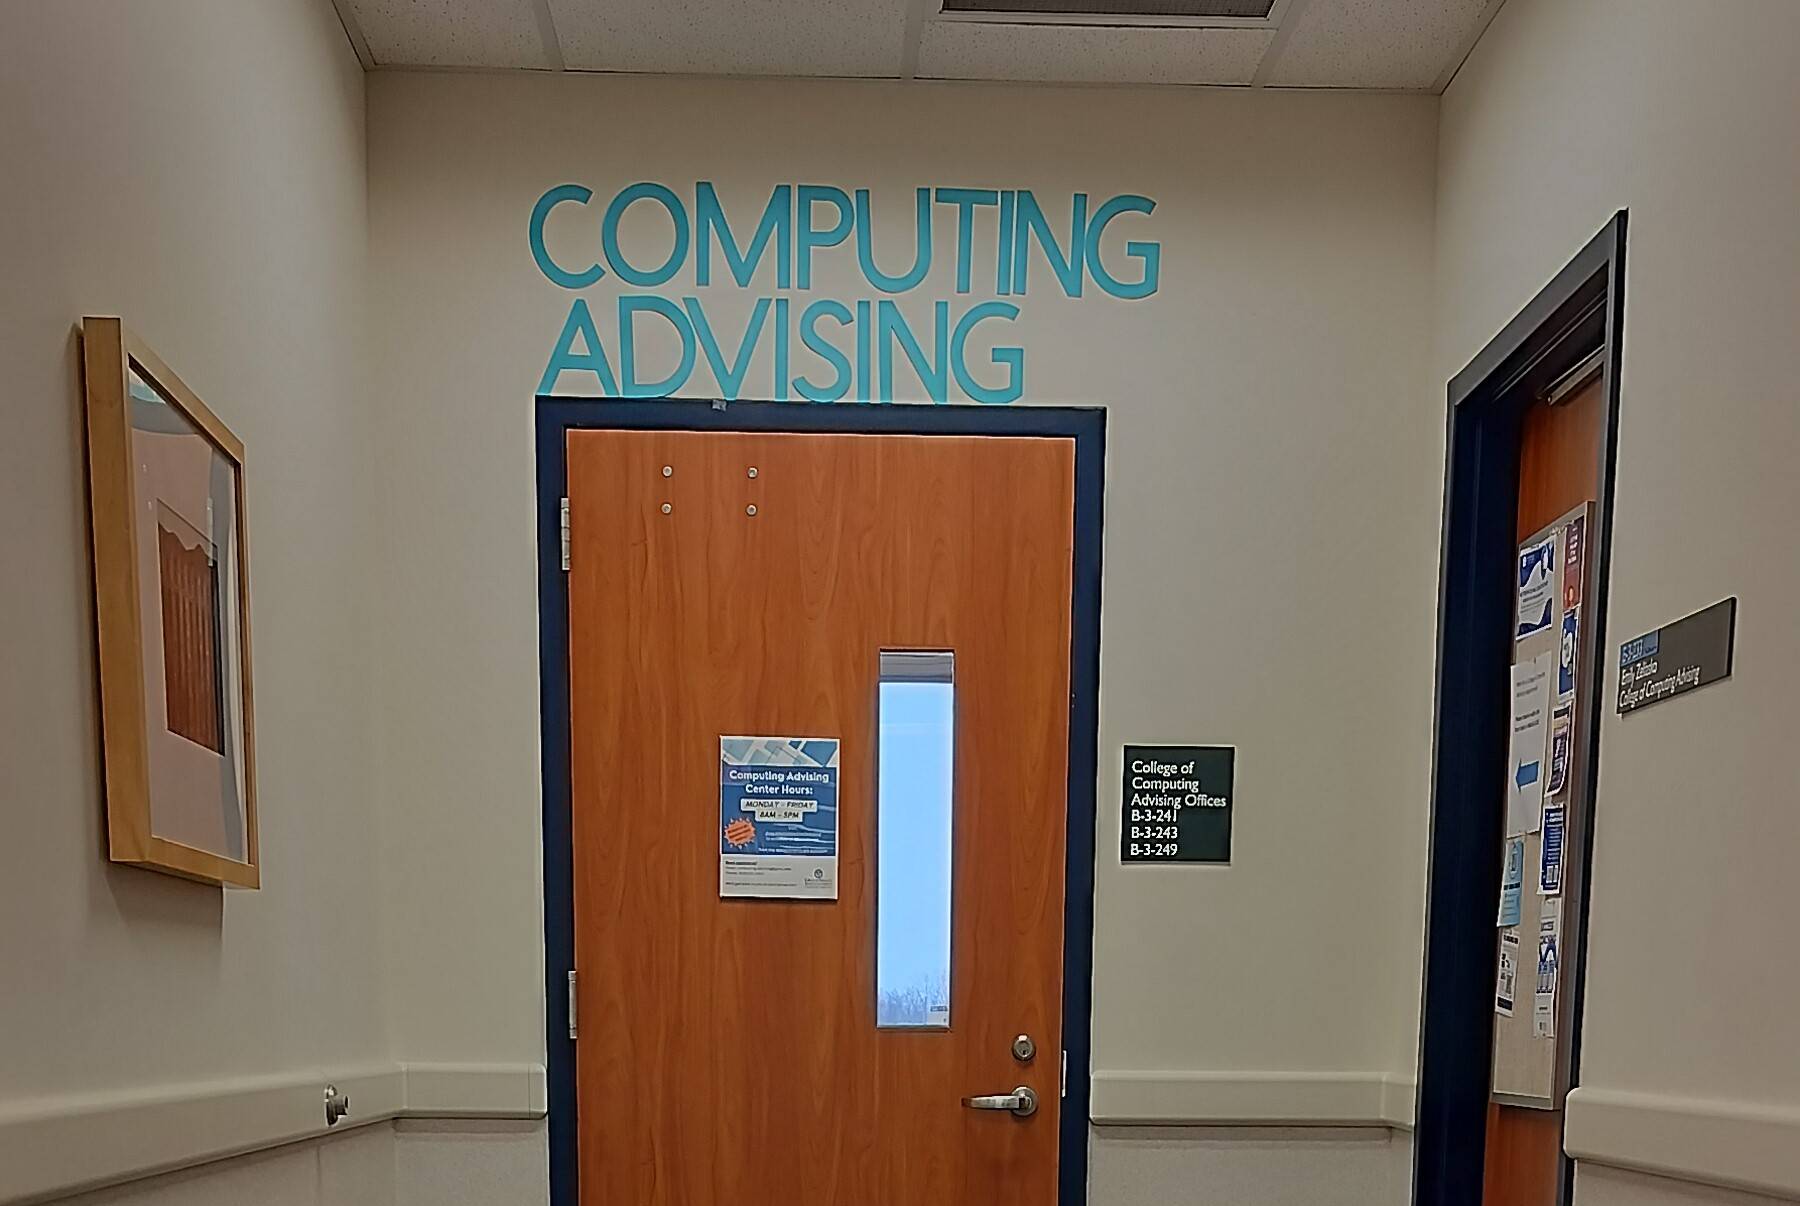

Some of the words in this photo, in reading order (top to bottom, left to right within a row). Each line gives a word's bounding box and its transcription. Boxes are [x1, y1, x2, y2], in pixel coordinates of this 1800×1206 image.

[529, 182, 1160, 299] COMPUTING
[535, 296, 1024, 404] ADVISING
[1131, 760, 1178, 777] College
[1180, 761, 1195, 774] of
[729, 770, 784, 782] Computing
[786, 771, 829, 783] Advising
[745, 784, 779, 794] Center
[781, 785, 813, 795] Hours:
[1131, 777, 1199, 793] Computing
[1130, 793, 1181, 809] Advising
[1184, 794, 1226, 807] Offices
[1131, 809, 1177, 822] B-3-241
[1131, 826, 1178, 839] B-3-243
[1130, 843, 1178, 856] B-3-249
